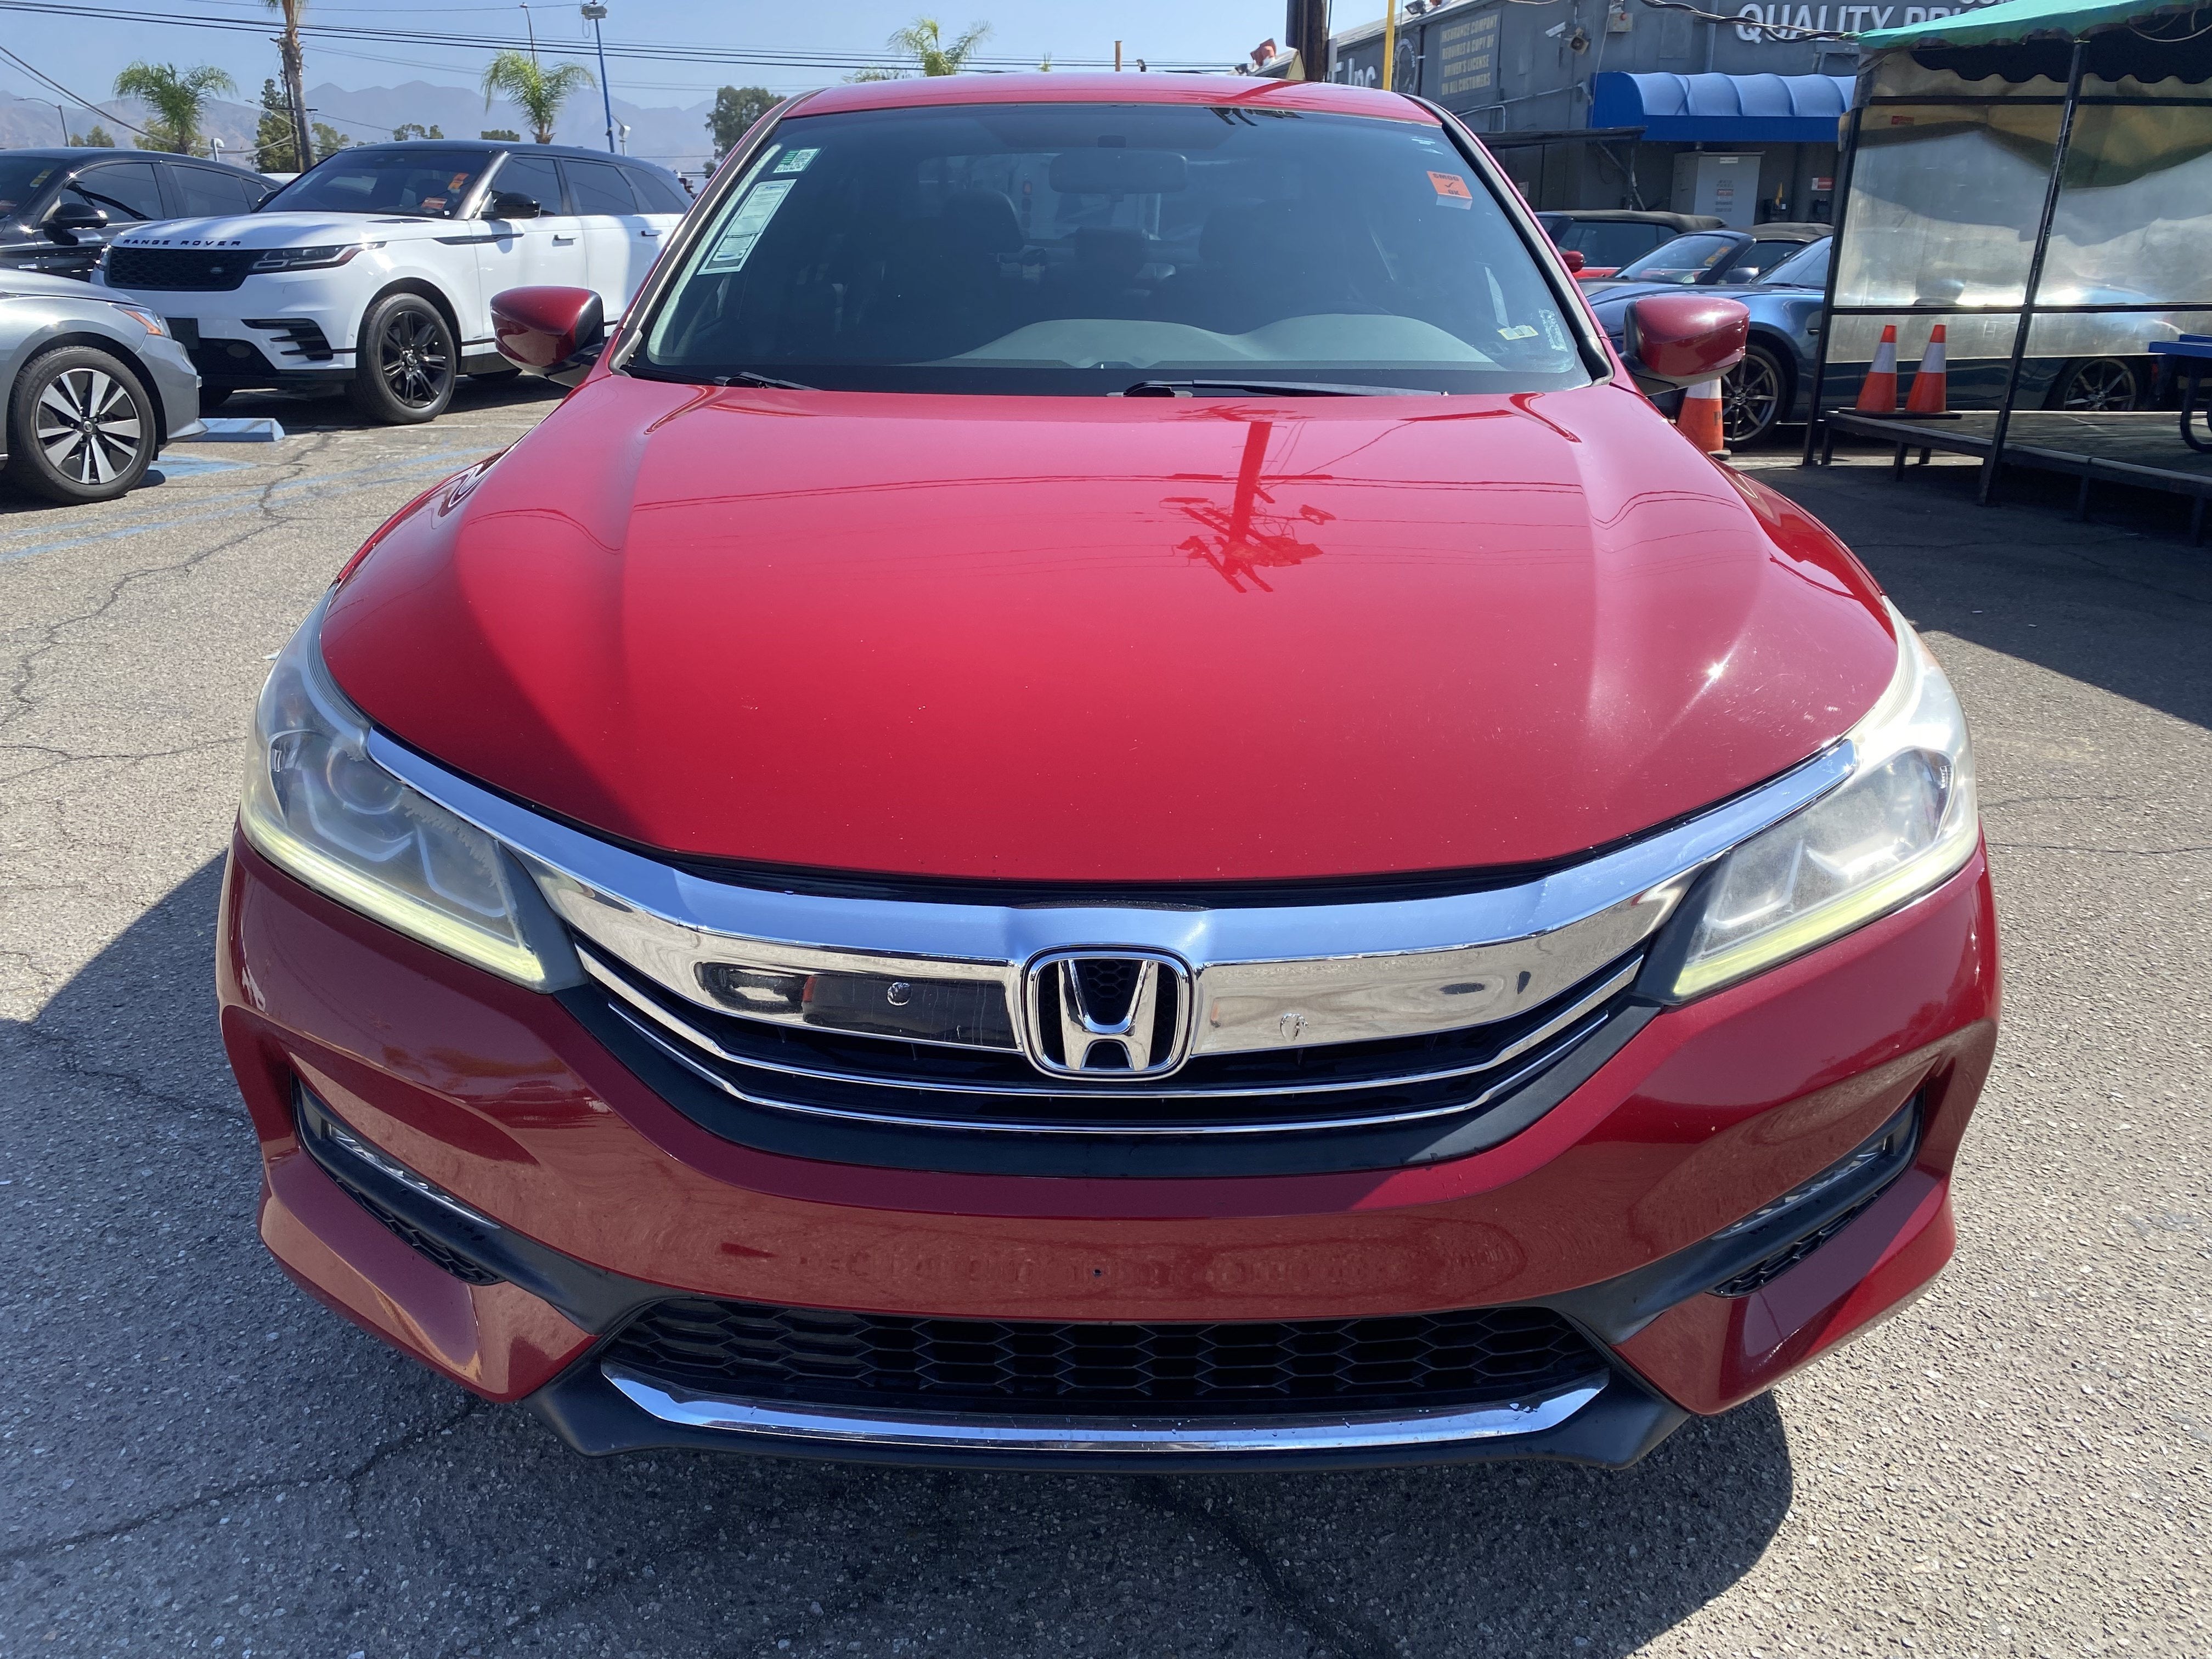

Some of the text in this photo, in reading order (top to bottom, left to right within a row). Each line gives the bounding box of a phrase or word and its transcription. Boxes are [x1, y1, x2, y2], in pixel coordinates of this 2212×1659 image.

[1442, 14, 1498, 42] INSURANCE COMPANY
[1735, 3, 1894, 44] QUALITY
[1442, 42, 1466, 60] REQUIRES
[1471, 36, 1486, 52] COPY
[1487, 35, 1494, 48] OF
[1468, 54, 1489, 71] LICENSE
[1442, 72, 1491, 95] ON ALL CUSTOMERS
